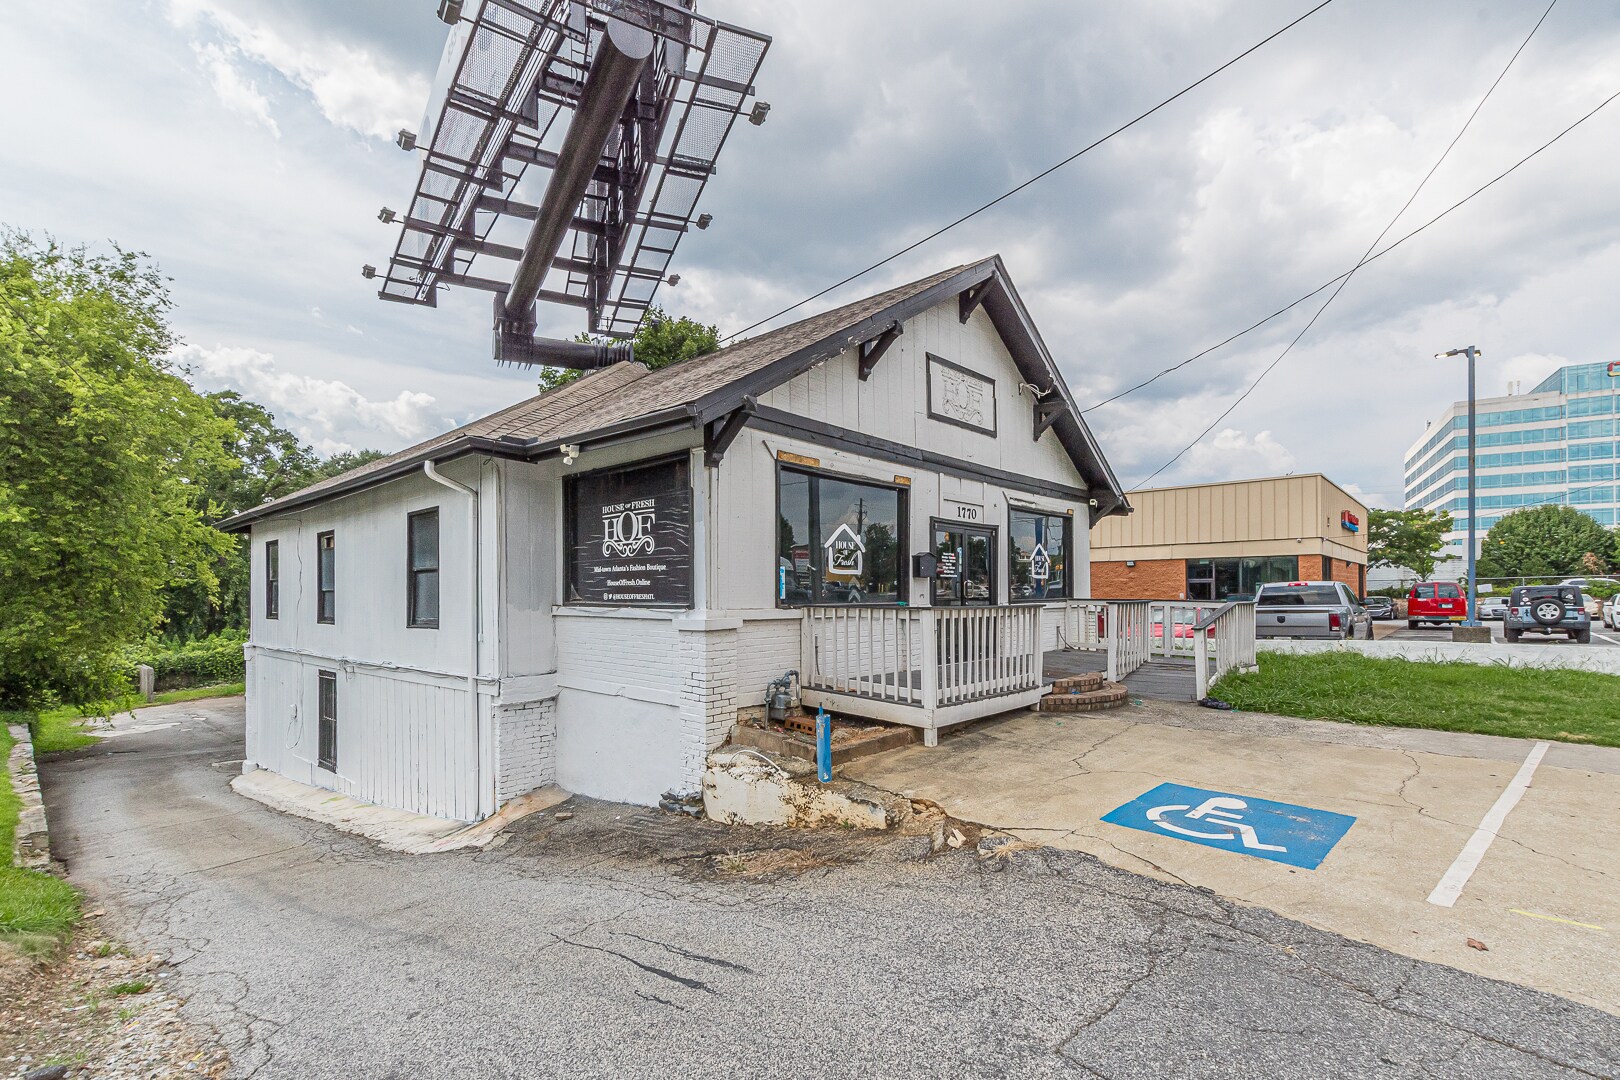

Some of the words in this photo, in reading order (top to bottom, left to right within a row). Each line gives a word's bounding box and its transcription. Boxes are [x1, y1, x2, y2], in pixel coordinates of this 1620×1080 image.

[602, 503, 624, 514] HOUSE
[631, 499, 655, 509] FRESH
[957, 506, 977, 519] 1770
[602, 511, 656, 543] HOF
[647, 563, 666, 572] Boutique
